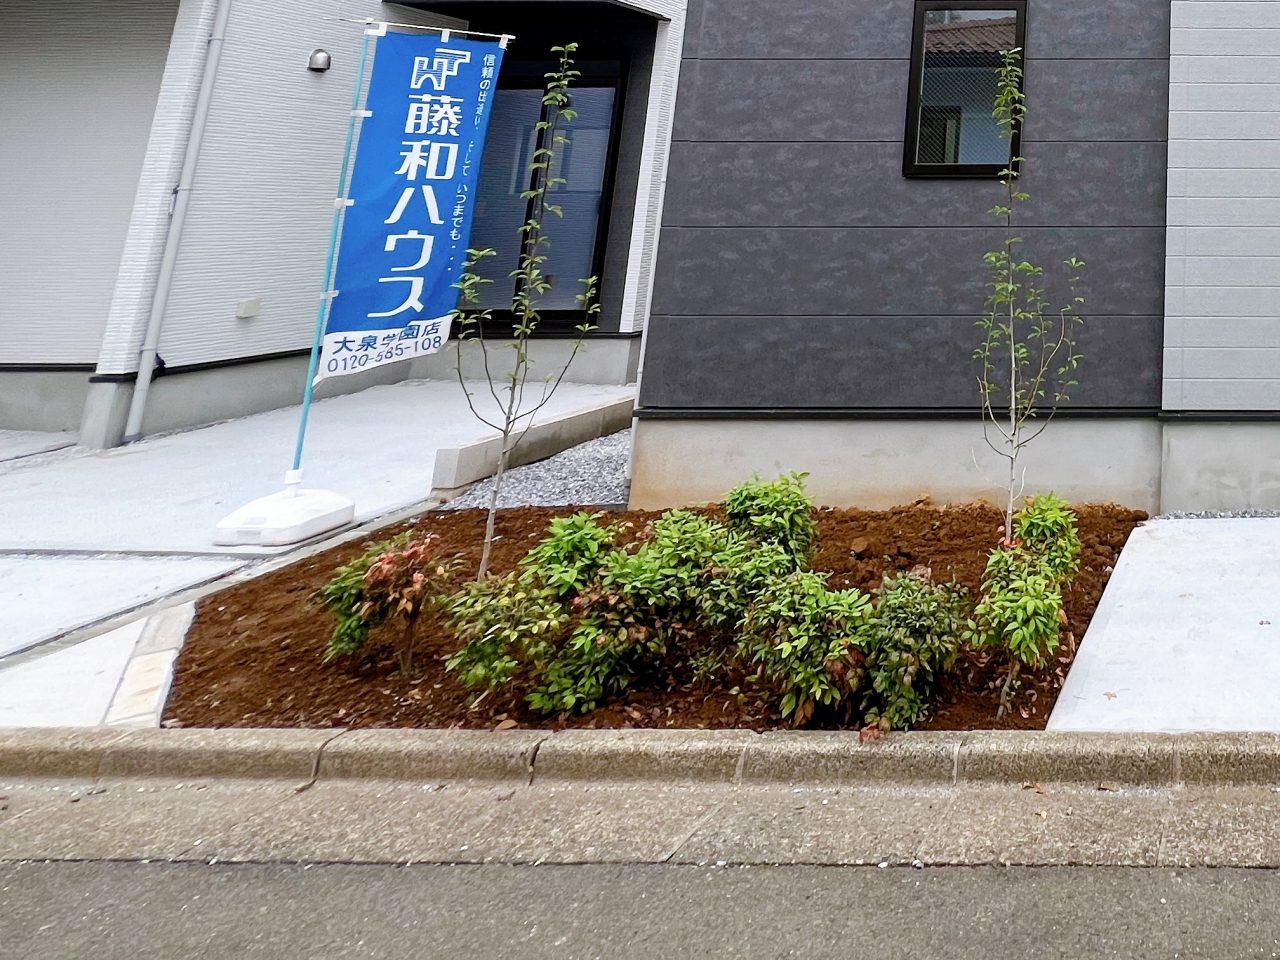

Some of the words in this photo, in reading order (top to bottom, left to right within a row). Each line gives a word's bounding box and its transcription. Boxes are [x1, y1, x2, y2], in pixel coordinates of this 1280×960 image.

[367, 94, 464, 318] 藤和ハウス
[327, 336, 442, 373] 0120-585-108
[332, 321, 442, 355] 大泉学園店
